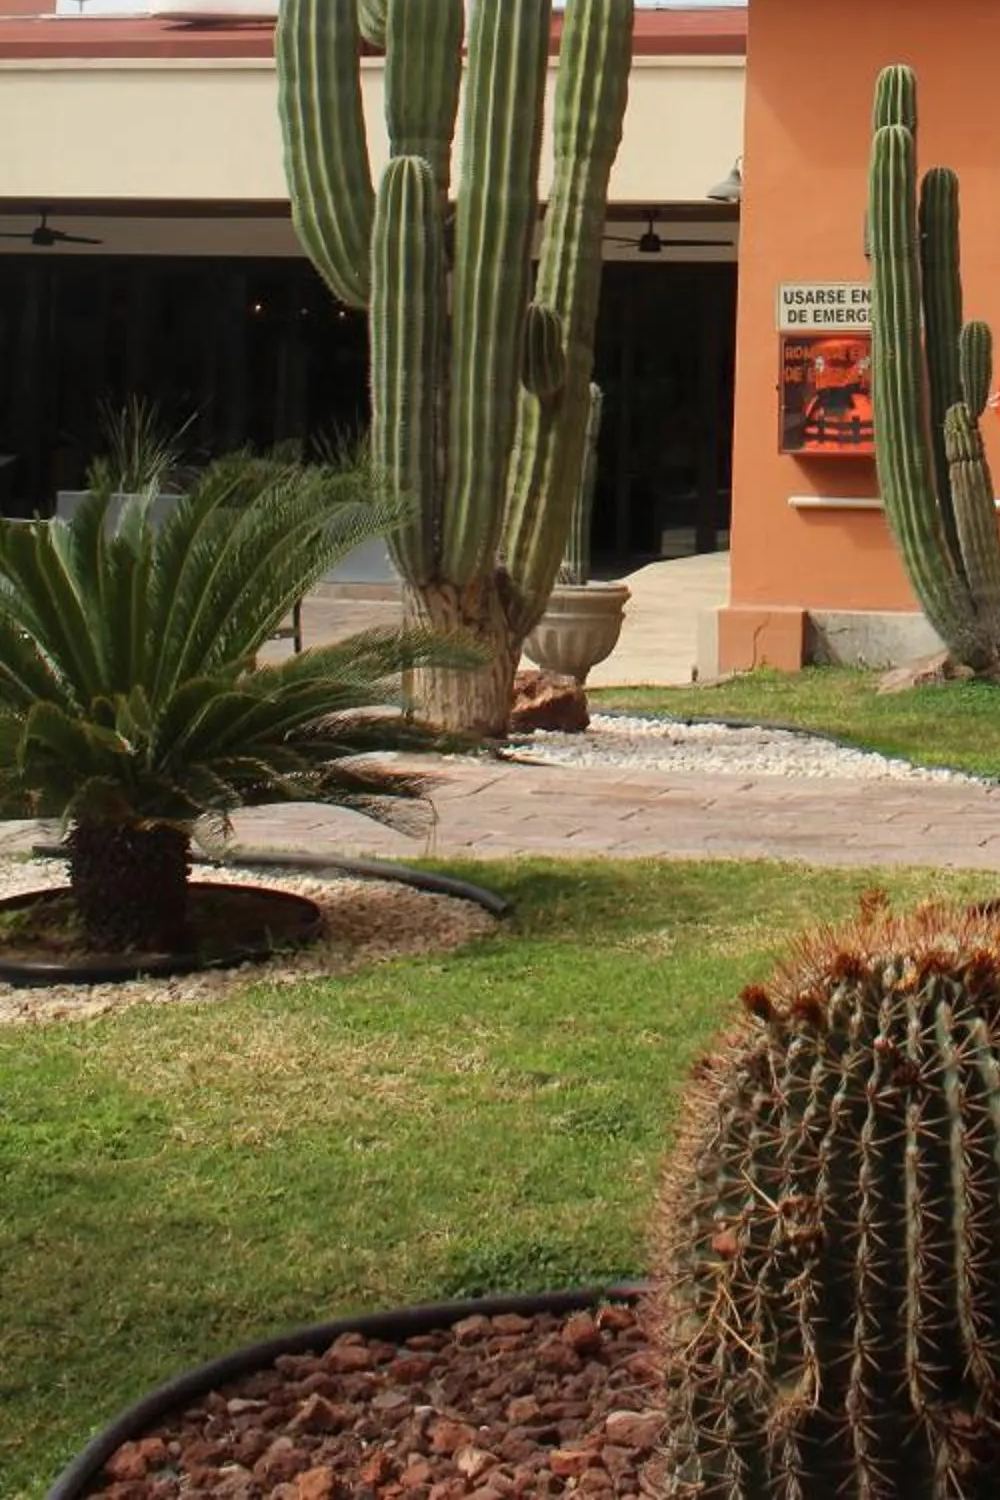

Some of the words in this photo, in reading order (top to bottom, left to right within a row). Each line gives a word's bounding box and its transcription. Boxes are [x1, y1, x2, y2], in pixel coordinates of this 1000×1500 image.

[784, 289, 846, 304] USARSE
[851, 289, 872, 303] EN
[788, 309, 808, 322] DE
[813, 309, 872, 323] EMERG
